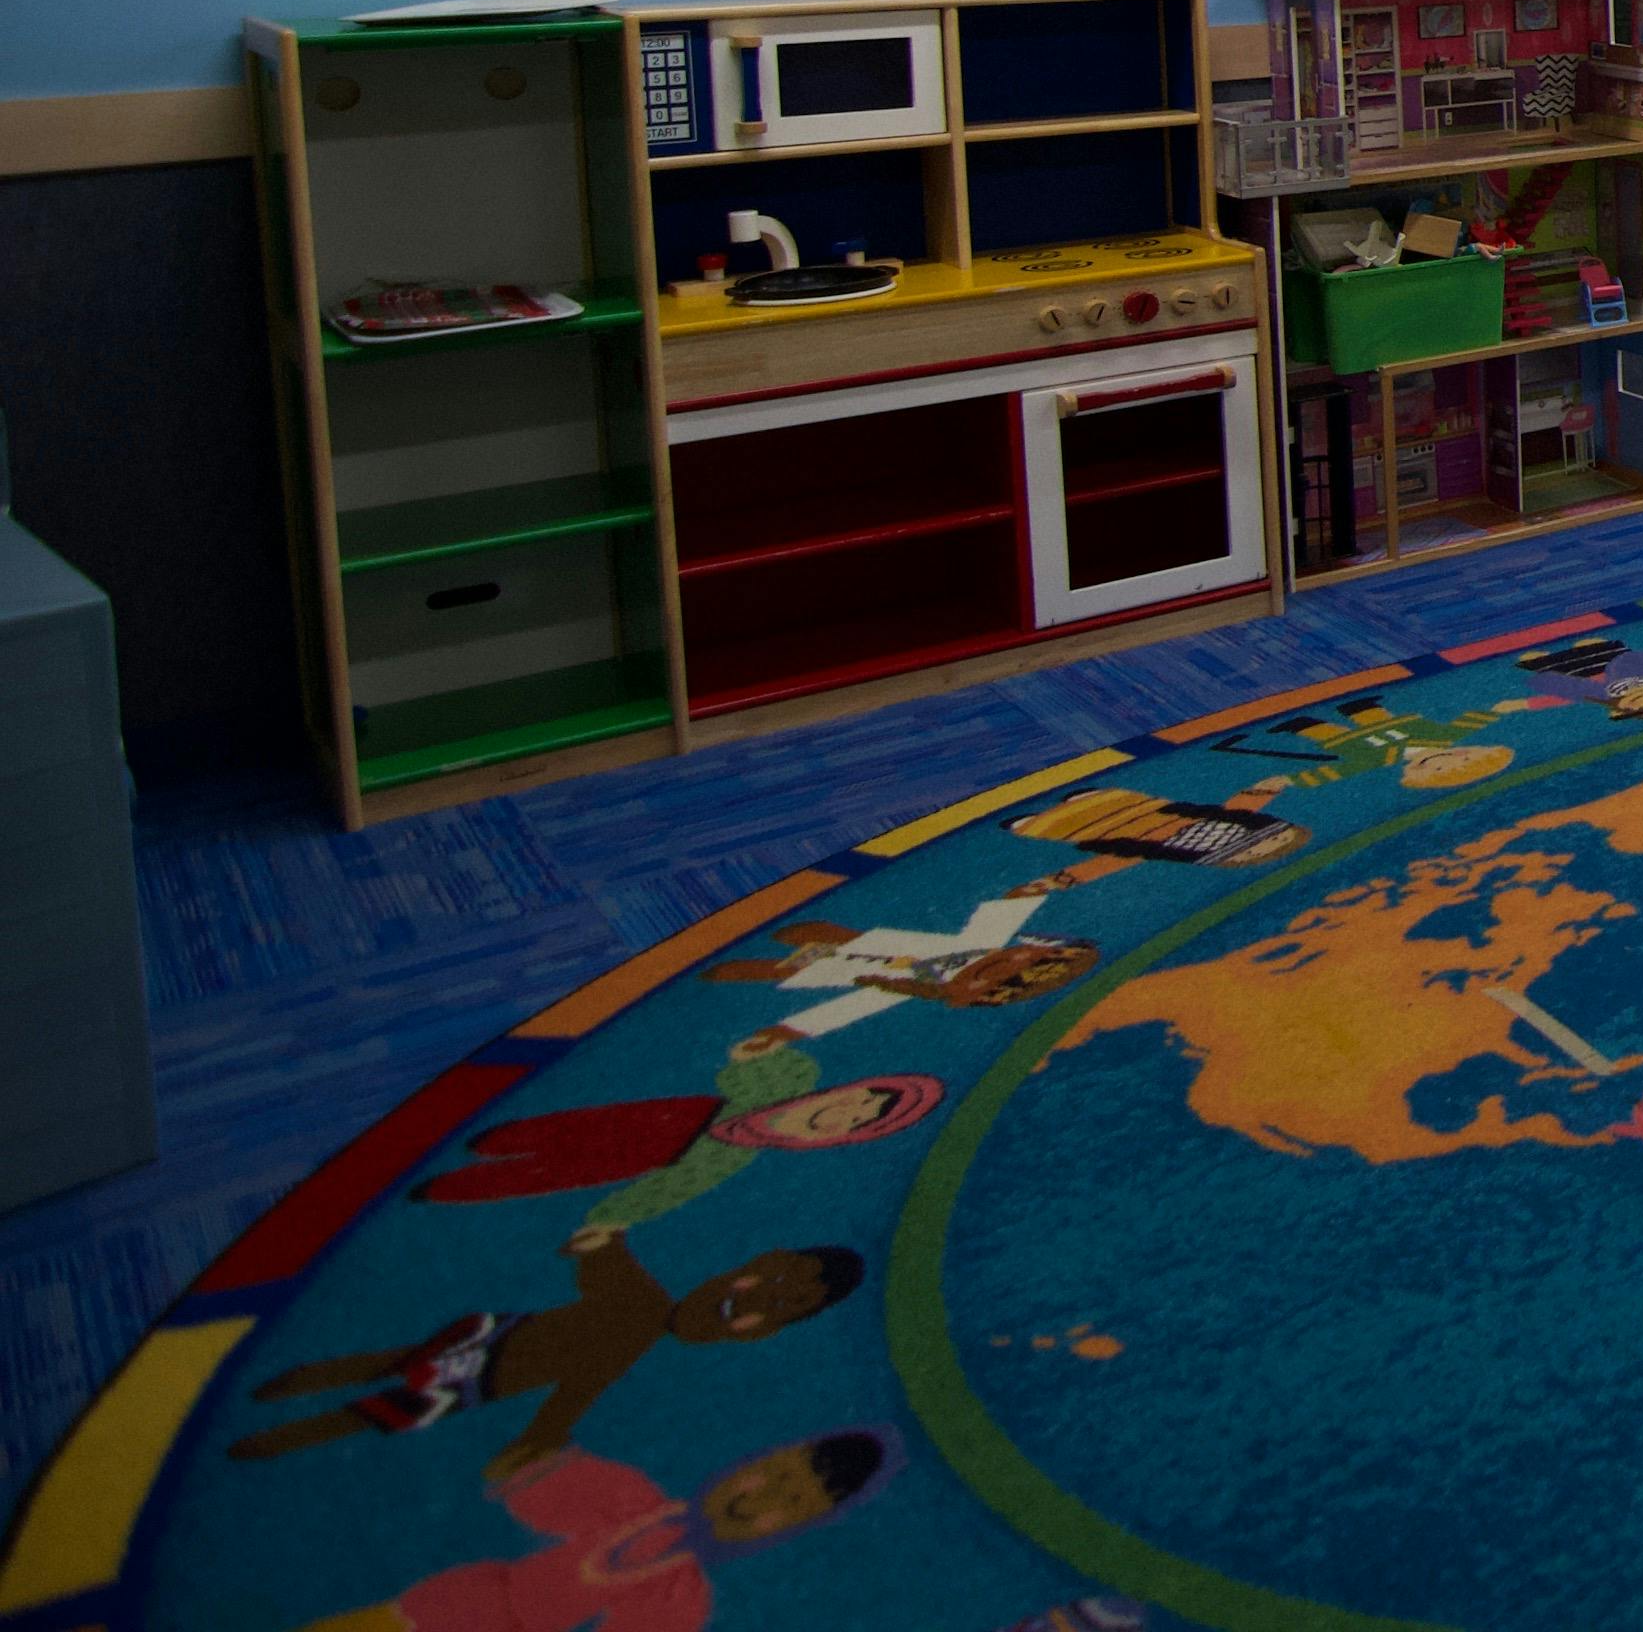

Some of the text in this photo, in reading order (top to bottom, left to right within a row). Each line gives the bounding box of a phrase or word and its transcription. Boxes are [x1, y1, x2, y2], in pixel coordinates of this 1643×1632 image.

[652, 55, 679, 65] 2 3
[654, 73, 681, 84] 5 6
[655, 91, 681, 102] 8 9
[656, 110, 663, 120] 0
